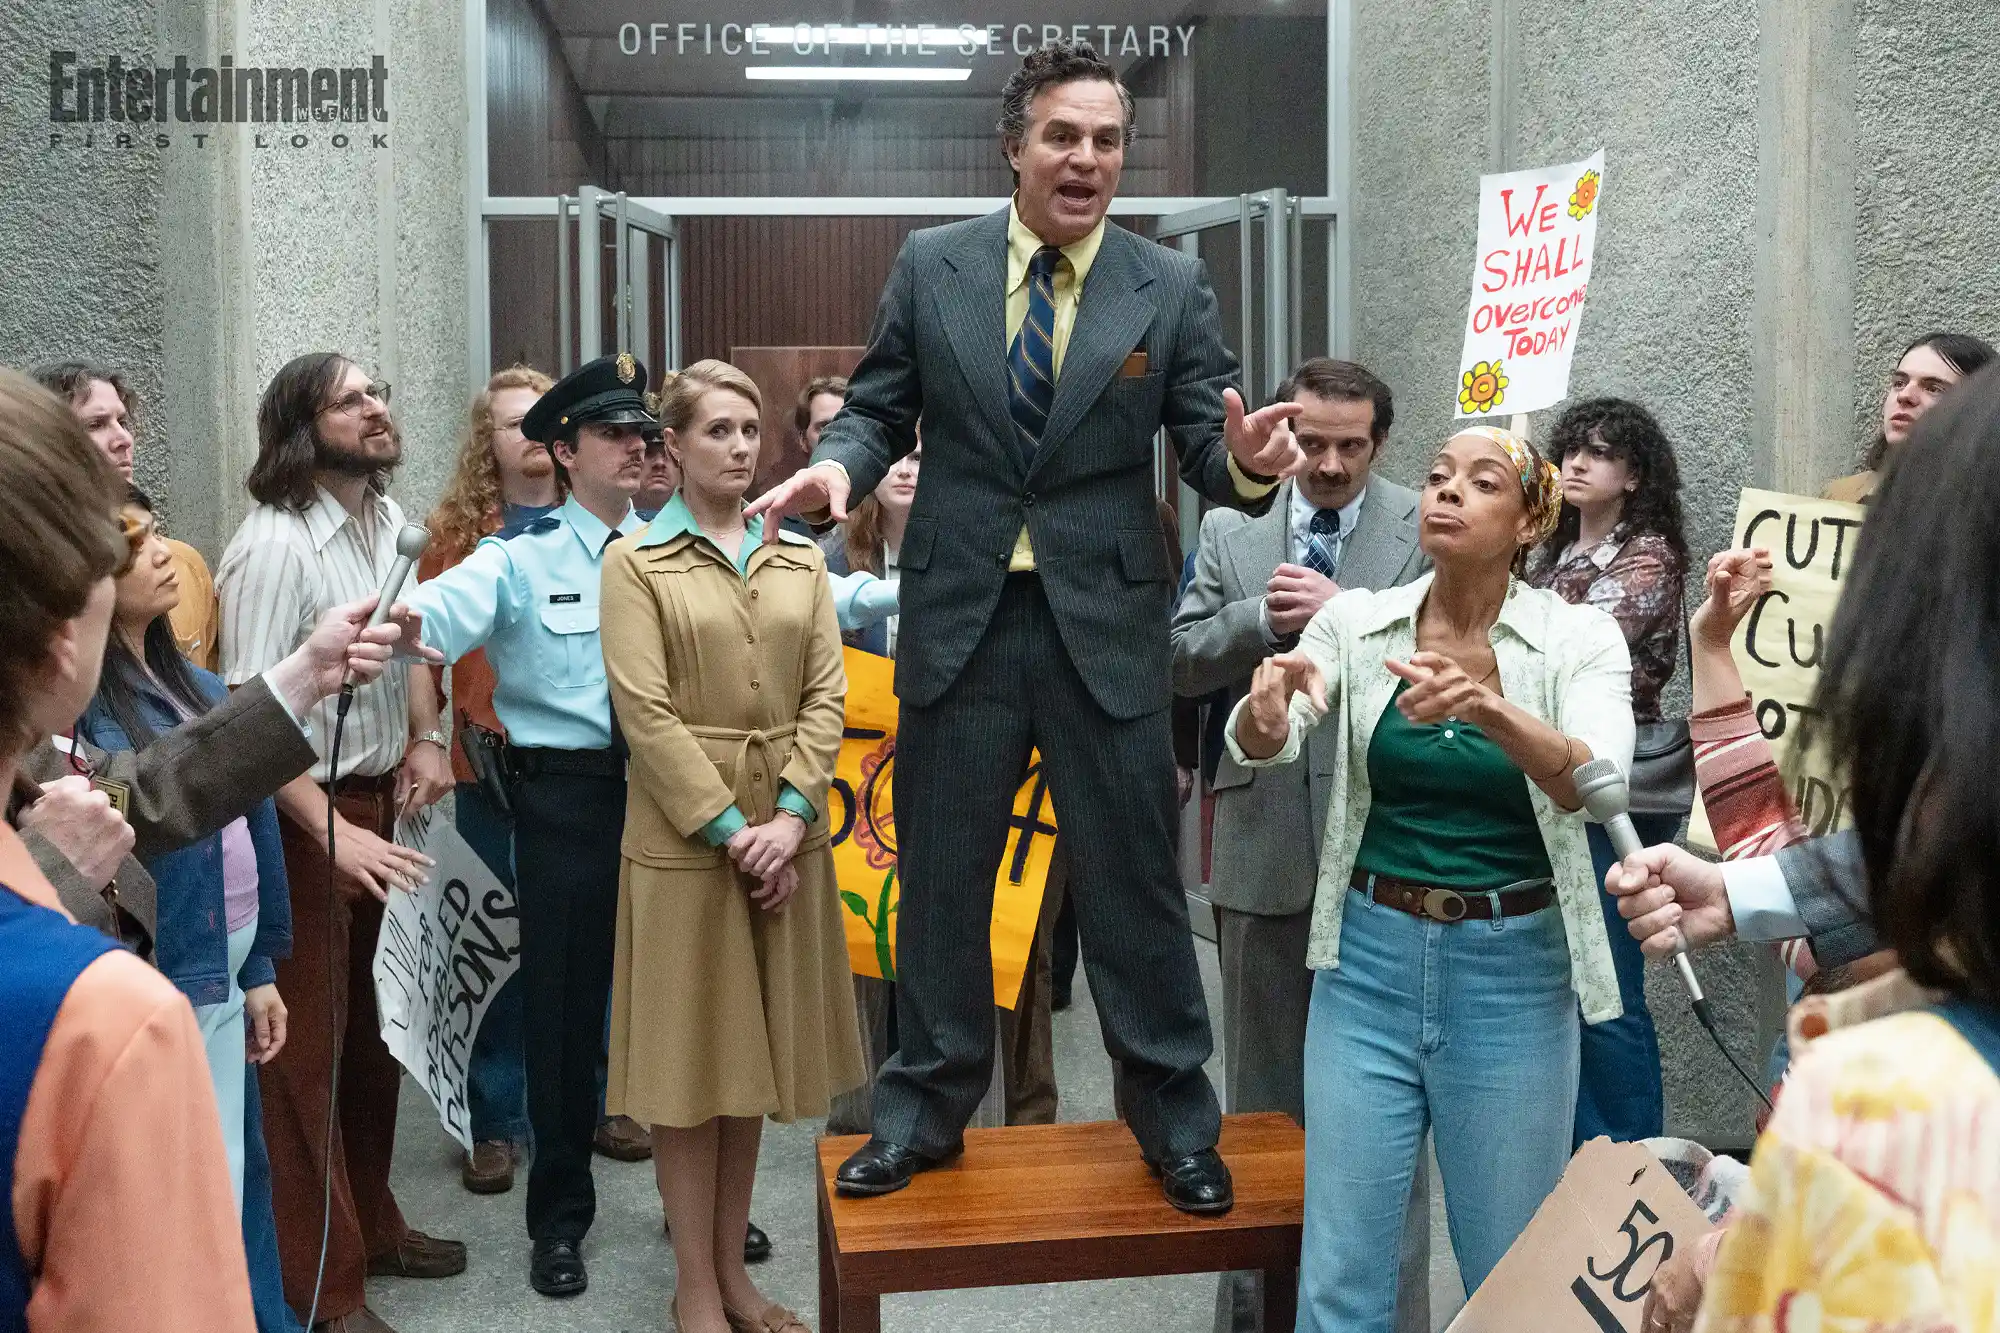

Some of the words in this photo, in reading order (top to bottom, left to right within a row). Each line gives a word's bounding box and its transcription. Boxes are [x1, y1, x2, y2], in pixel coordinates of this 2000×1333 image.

[619, 22, 771, 56] OFFICE
[793, 22, 842, 56] OF
[857, 23, 936, 56] THE
[958, 23, 1196, 57] SECRETARY
[1482, 234, 1584, 293] SHALL
[418, 911, 434, 1007] FOR
[426, 879, 470, 1105] DISABLED
